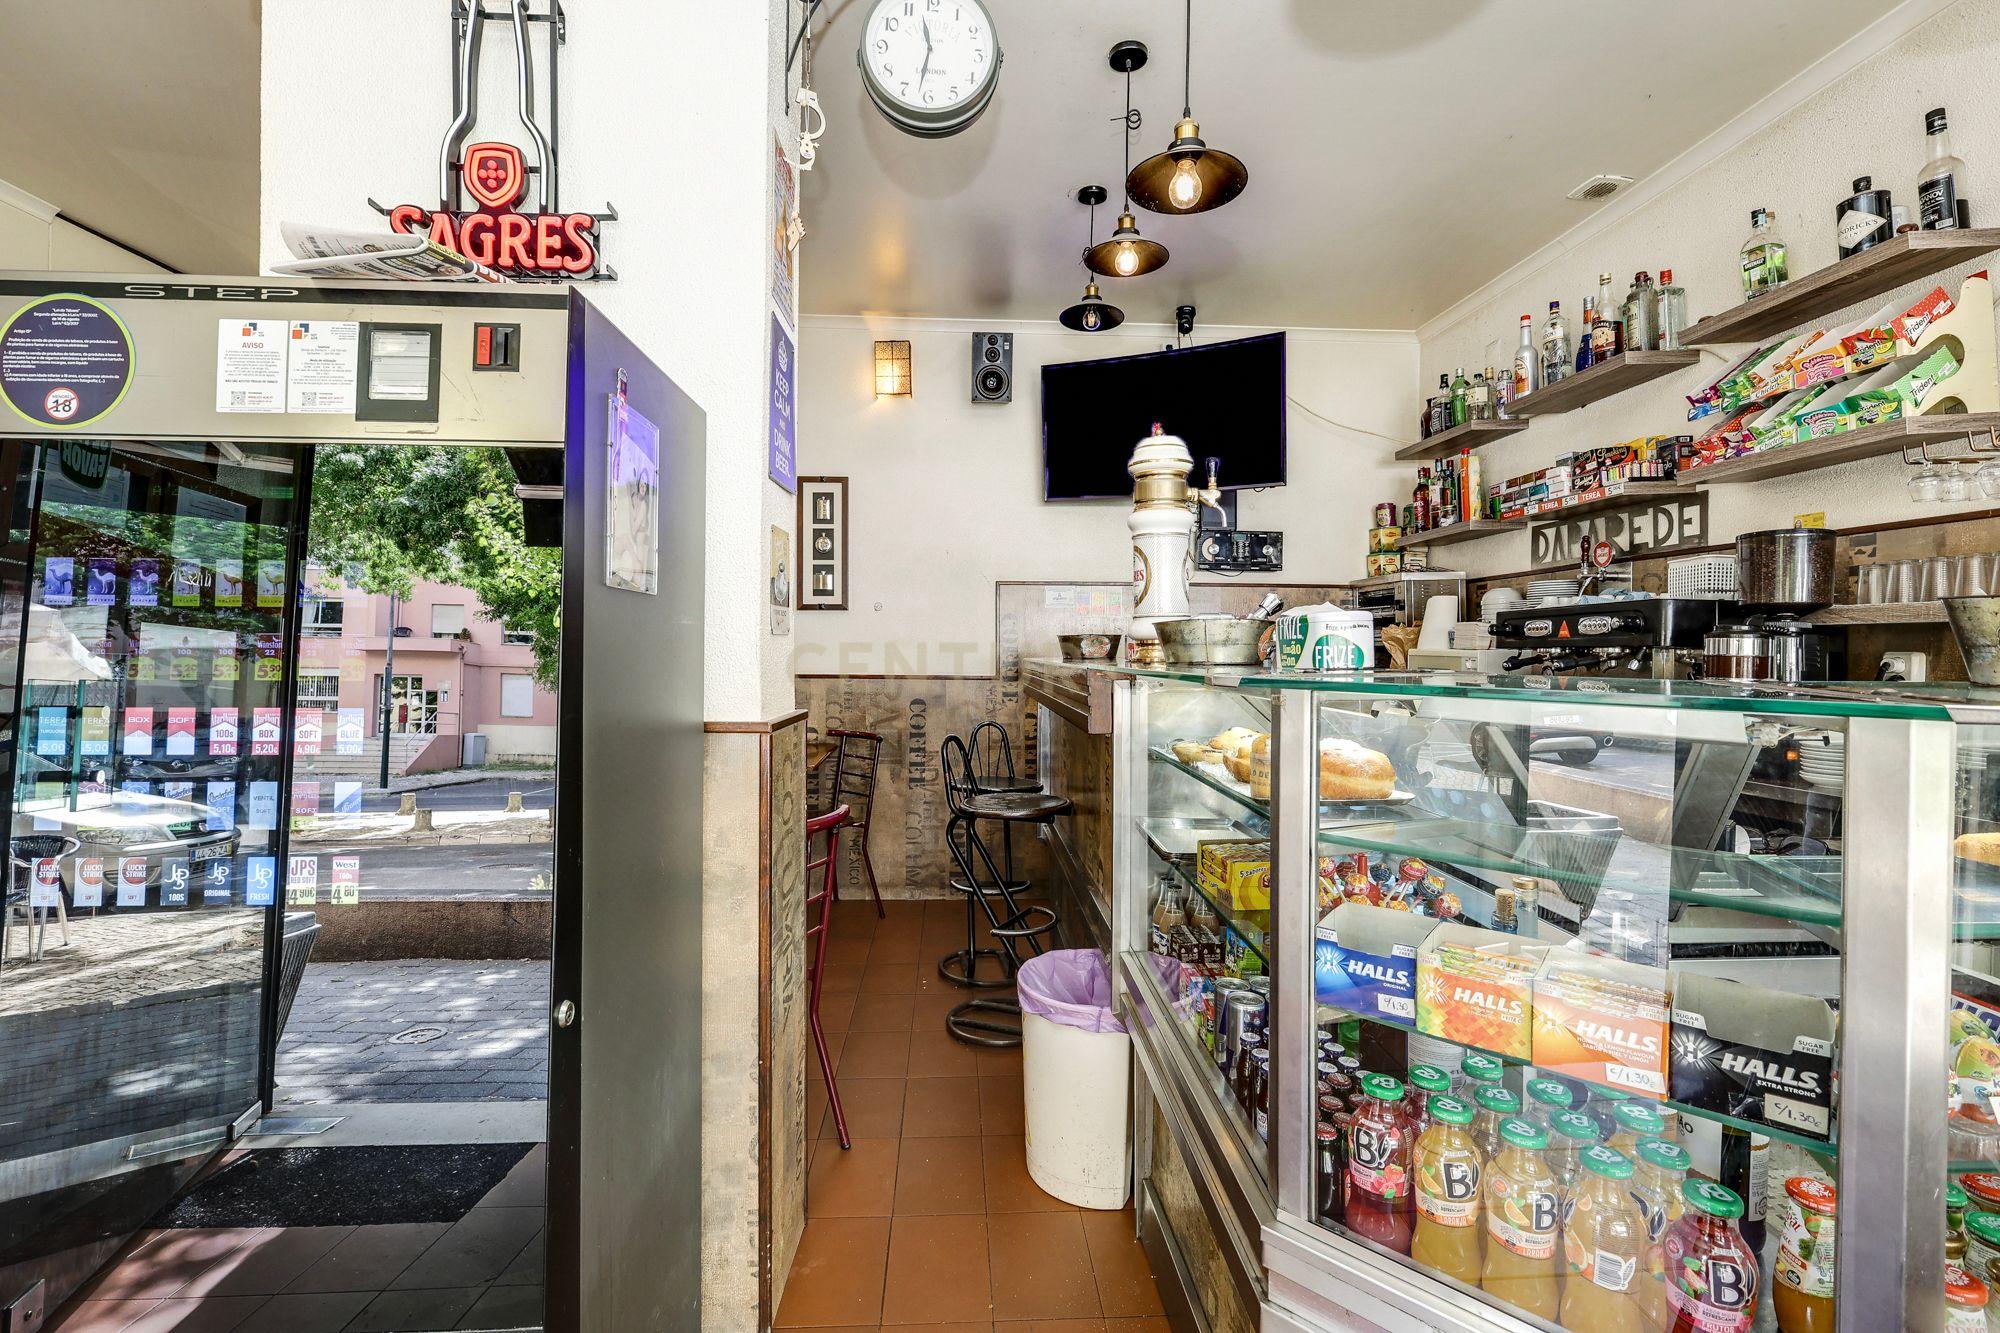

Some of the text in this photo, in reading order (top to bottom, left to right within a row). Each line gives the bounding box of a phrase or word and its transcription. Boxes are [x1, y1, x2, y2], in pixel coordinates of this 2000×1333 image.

[903, 2, 914, 17] 11
[926, 0, 941, 13] 12
[955, 8, 960, 22] 1
[884, 16, 899, 33] 10
[967, 25, 979, 40] 2
[876, 39, 889, 54] 9
[973, 48, 984, 64] 3
[882, 62, 894, 78] 8
[964, 71, 975, 85] 4
[900, 81, 910, 97] 7
[947, 86, 959, 101] 5
[922, 90, 934, 105] 6
[124, 284, 300, 300] STEP
[1905, 313, 1930, 336] Trident
[1910, 374, 1936, 398] Trident
[52, 398, 72, 413] 18
[1581, 491, 1601, 501] TEREA
[1541, 502, 1559, 511] TEREA
[1279, 617, 1305, 640] FRIZE
[1315, 644, 1356, 669] FRIZE
[216, 730, 234, 738] 100s
[258, 730, 275, 738] BOX
[299, 730, 319, 739] SOFT
[340, 730, 360, 739] BLUE
[907, 697, 928, 790] COFFEE
[290, 859, 316, 877] JPS
[168, 893, 185, 901] 100S
[204, 889, 232, 897] ORIGINAL
[249, 893, 270, 901] FRESH
[1348, 960, 1409, 986] HALLS
[1453, 987, 1523, 1015] HALLS
[1675, 1012, 1700, 1023] SUGAR
[1679, 1018, 1695, 1027] FREE
[1576, 1020, 1658, 1053] HALLS
[1798, 1040, 1824, 1050] SUGAR
[1801, 1046, 1820, 1055] FREE
[1721, 1053, 1821, 1092] HALLS
[1756, 1079, 1817, 1099] EXTRA STRONG
[1440, 1216, 1468, 1226] LARANJA
